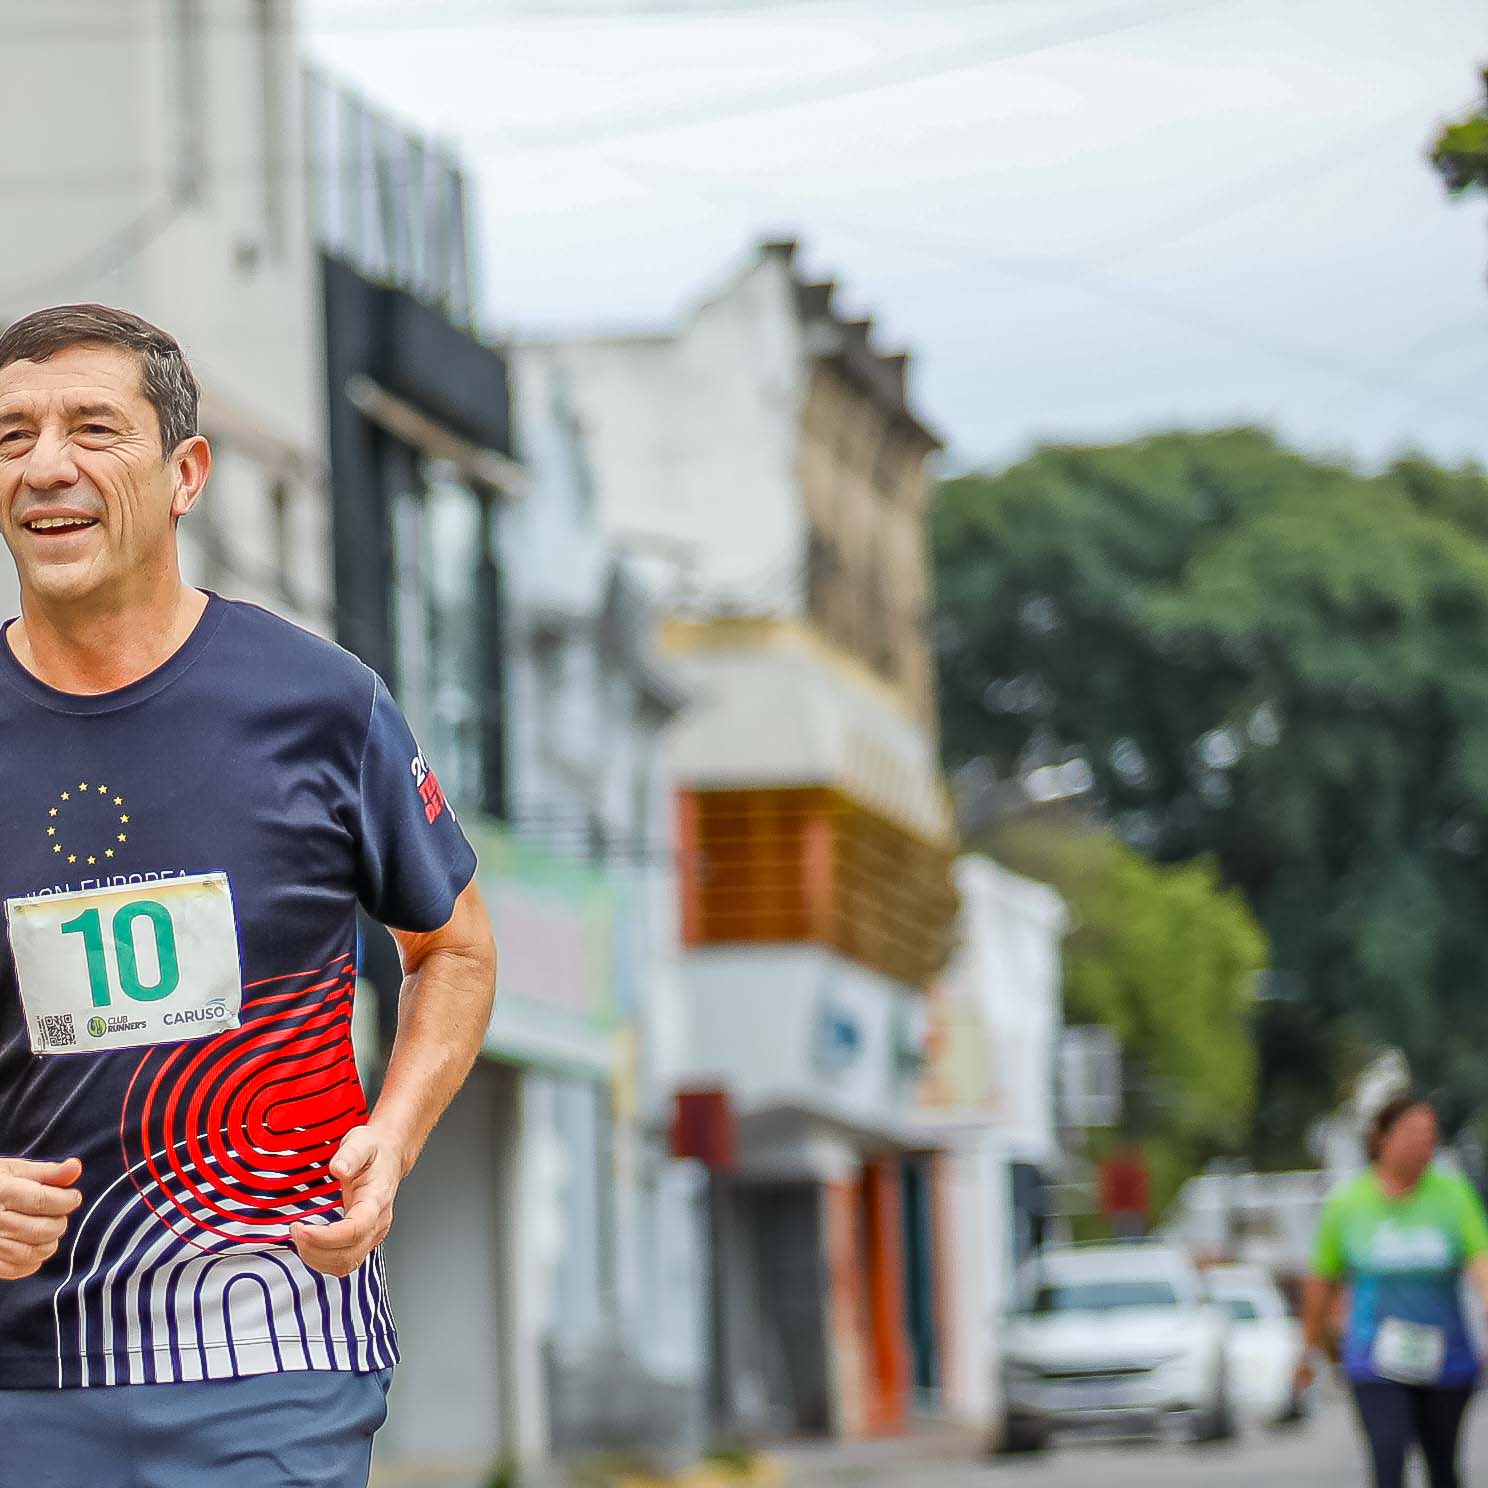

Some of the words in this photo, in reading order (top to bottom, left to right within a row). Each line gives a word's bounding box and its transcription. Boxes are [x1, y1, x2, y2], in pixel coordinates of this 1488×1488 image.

[61, 900, 180, 1007] 10
[108, 1015, 128, 1025] CLUB
[163, 1006, 225, 1026] CARUSO
